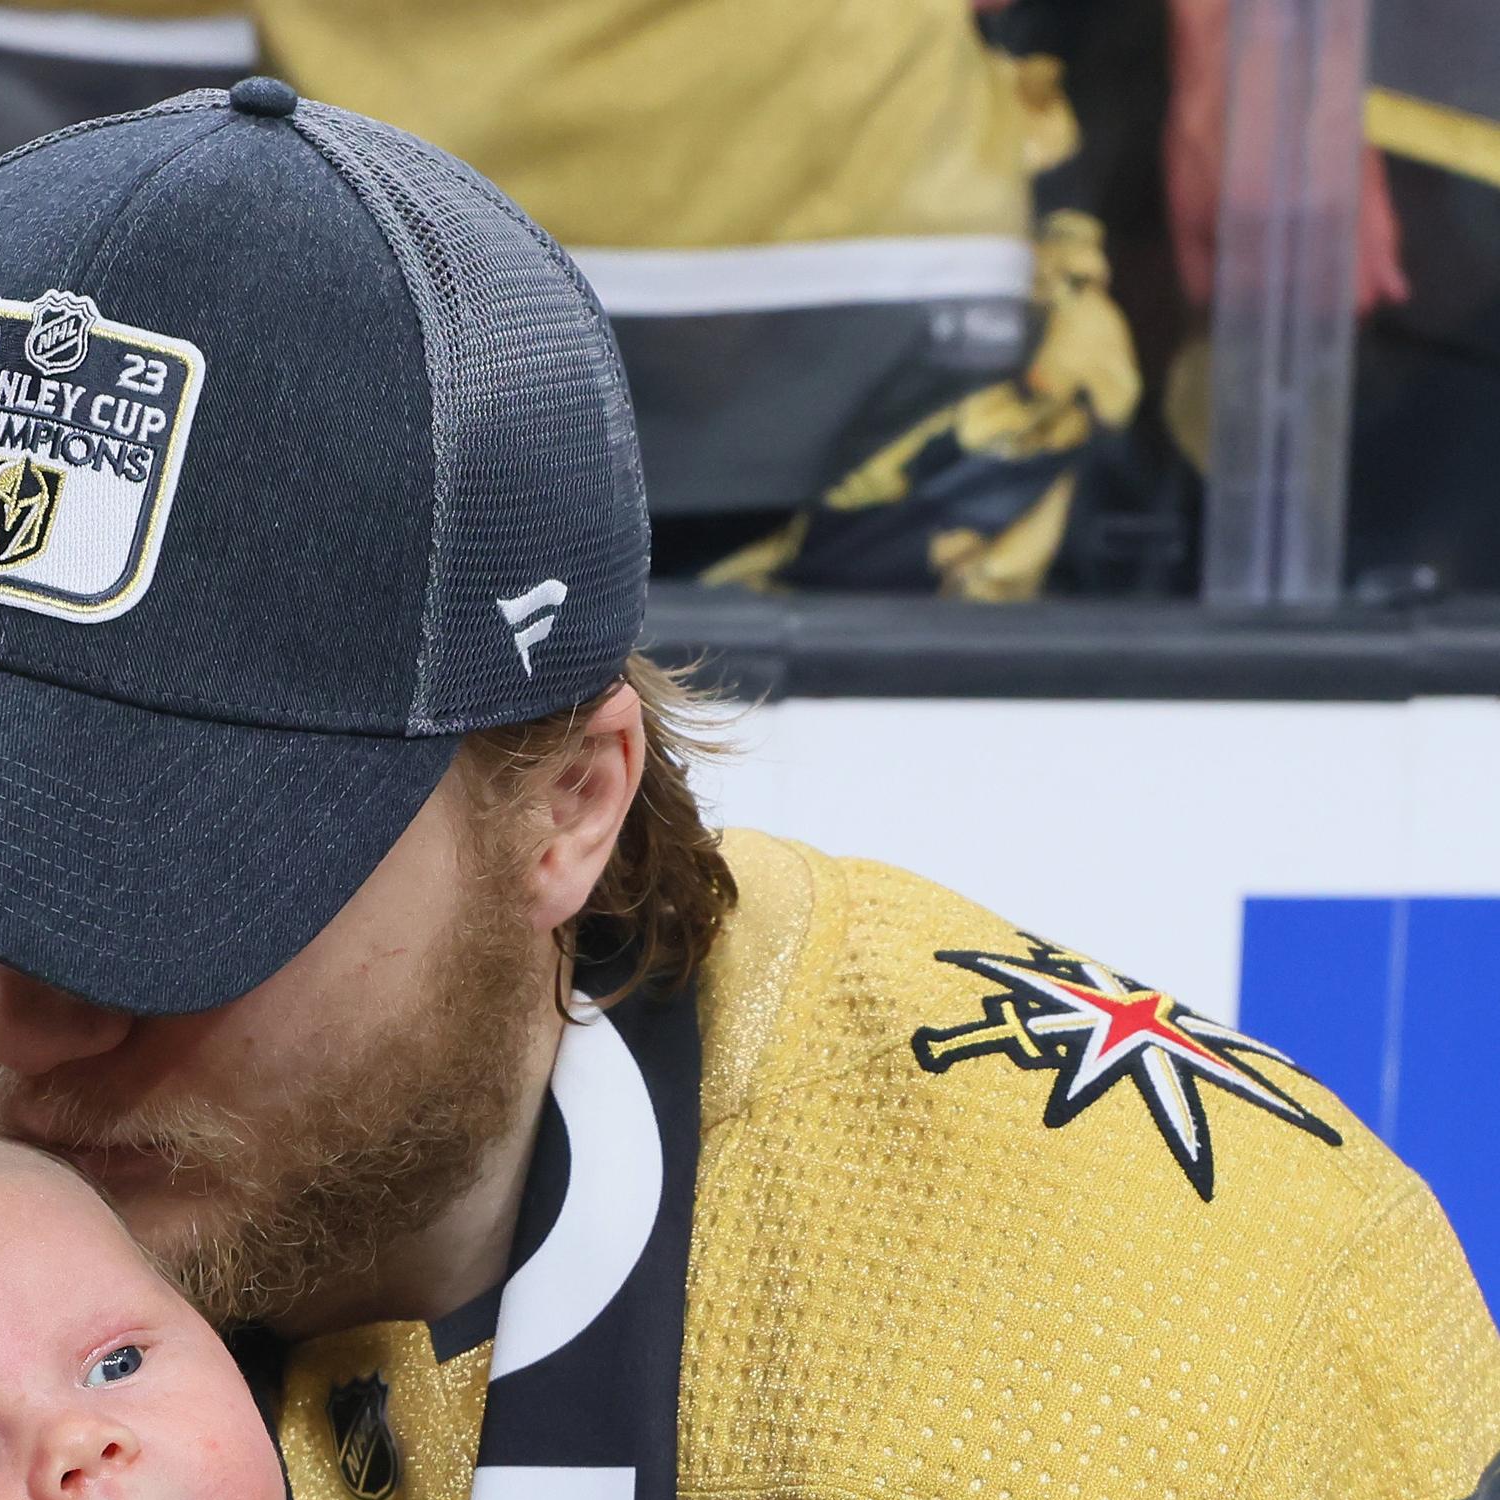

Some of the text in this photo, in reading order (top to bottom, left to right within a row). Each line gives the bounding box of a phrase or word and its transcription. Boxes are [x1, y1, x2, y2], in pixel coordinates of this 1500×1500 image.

[36, 318, 78, 354] NHL
[116, 353, 168, 395] 23
[89, 394, 167, 442] CUP
